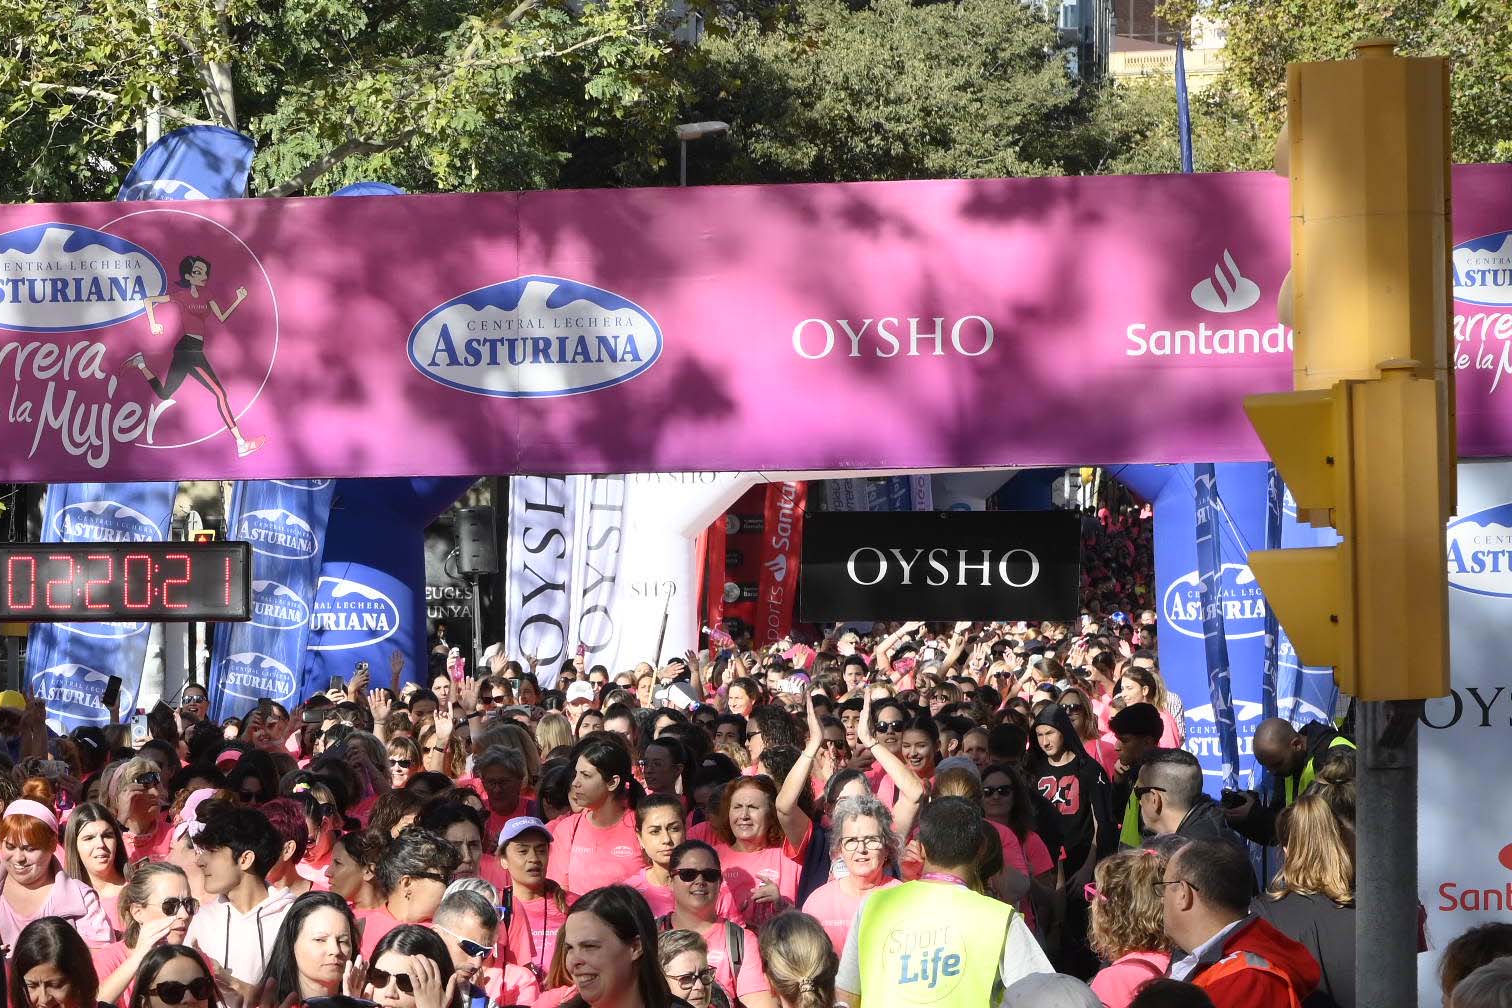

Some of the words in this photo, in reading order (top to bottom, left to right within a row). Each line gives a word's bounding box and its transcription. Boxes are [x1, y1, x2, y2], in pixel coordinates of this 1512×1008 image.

[69, 259, 142, 271] LECHERA
[466, 318, 545, 331] CENTRAL
[553, 316, 634, 329] LECHERA
[792, 315, 994, 359] OYSHO
[428, 323, 643, 368] ASTURIANA
[1476, 341, 1493, 370] la
[8, 385, 33, 424] la
[27, 375, 177, 468] Mujer
[62, 513, 153, 542] ASTURIANA
[240, 519, 312, 553] ASTURIANA
[847, 545, 1040, 588] OYSHO
[311, 610, 389, 632] URIANA
[1037, 775, 1080, 815] 23
[898, 947, 961, 989] Life
